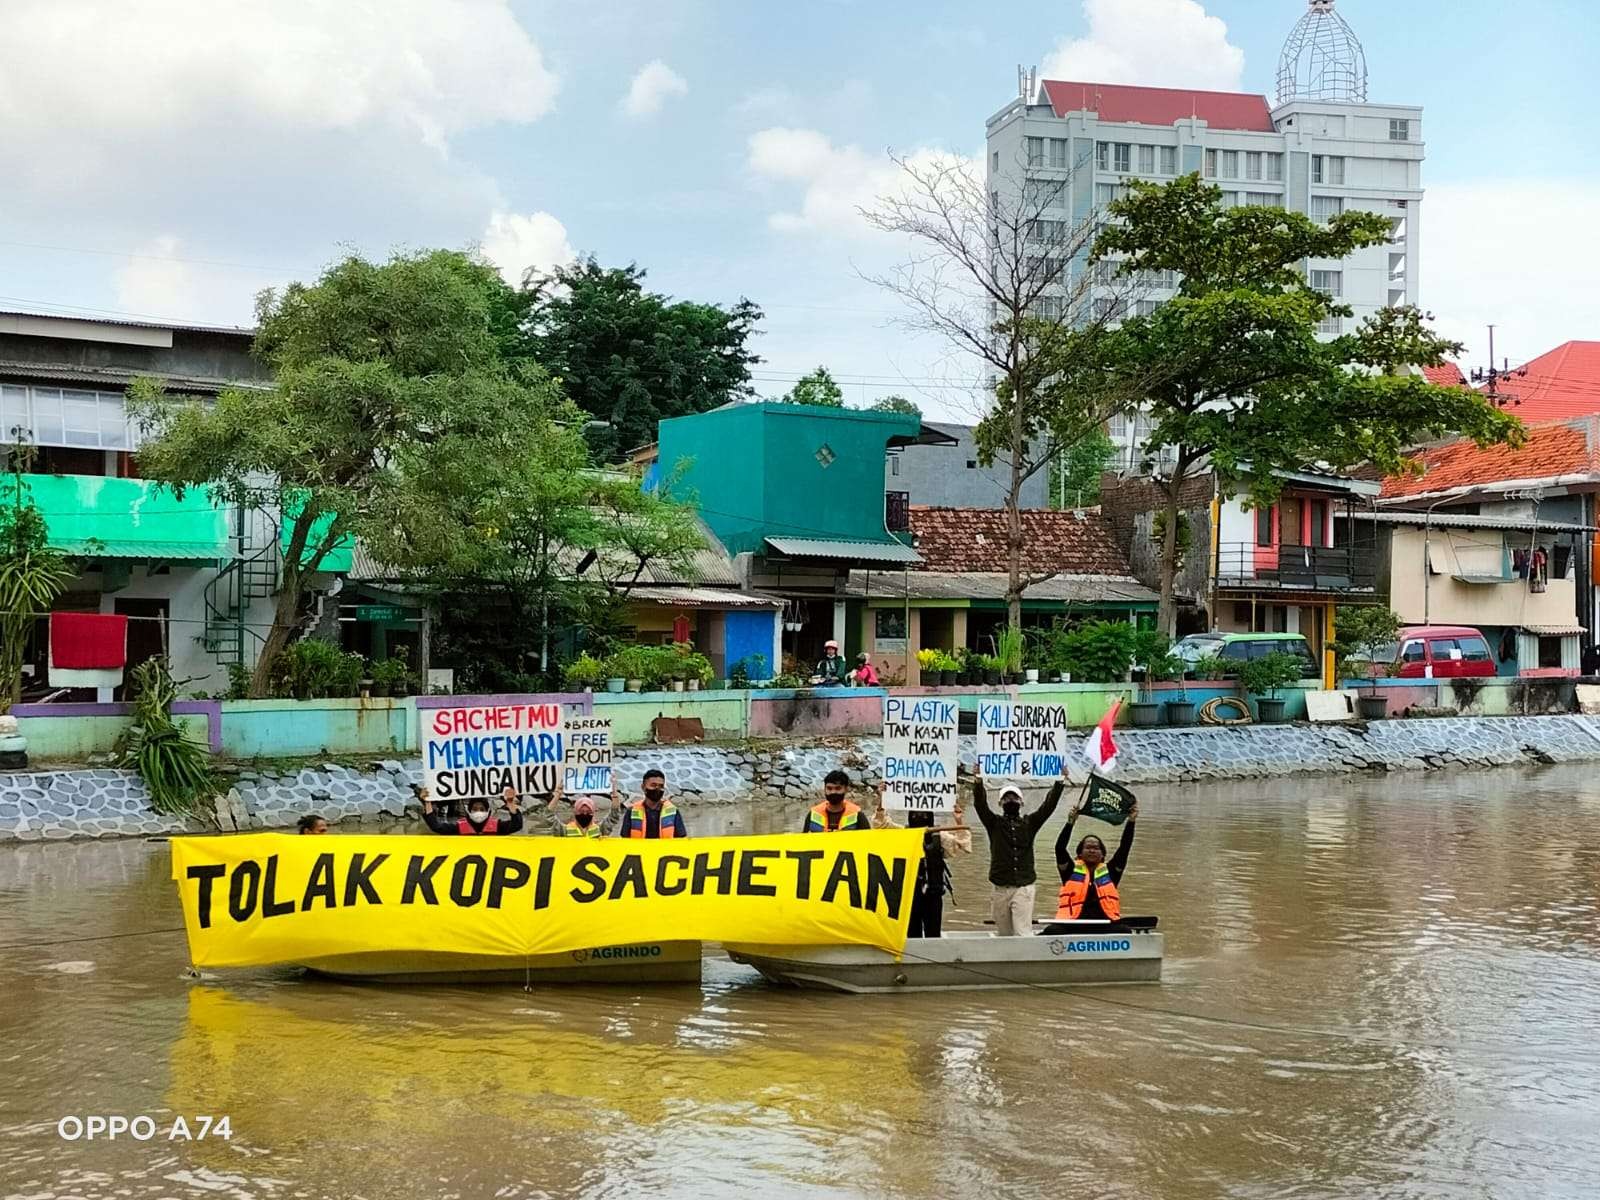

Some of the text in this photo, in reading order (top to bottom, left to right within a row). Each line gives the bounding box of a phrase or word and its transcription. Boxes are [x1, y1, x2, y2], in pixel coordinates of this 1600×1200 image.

[887, 700, 955, 724] PLASTIK
[980, 703, 1067, 729] KALI SURABAYA
[571, 733, 608, 746] FREE
[885, 723, 954, 740] TAK KASAT
[987, 730, 1057, 751] TERCEMAR
[428, 732, 563, 769] MENCEMARI
[565, 748, 611, 764] FROM
[908, 741, 940, 755] MATA
[885, 757, 946, 778] BAHAYA
[978, 753, 1065, 776] FOSFAT & KLORIN
[435, 765, 557, 797] SUNGAIKU
[565, 766, 611, 790] PLASTIC
[885, 781, 956, 794] MENGANCAM
[904, 795, 944, 809] NYATA
[187, 850, 907, 928] TOLAK KOPI SACHETAN
[591, 945, 661, 959] AGRINDO
[1066, 940, 1130, 952] AGRINDO
